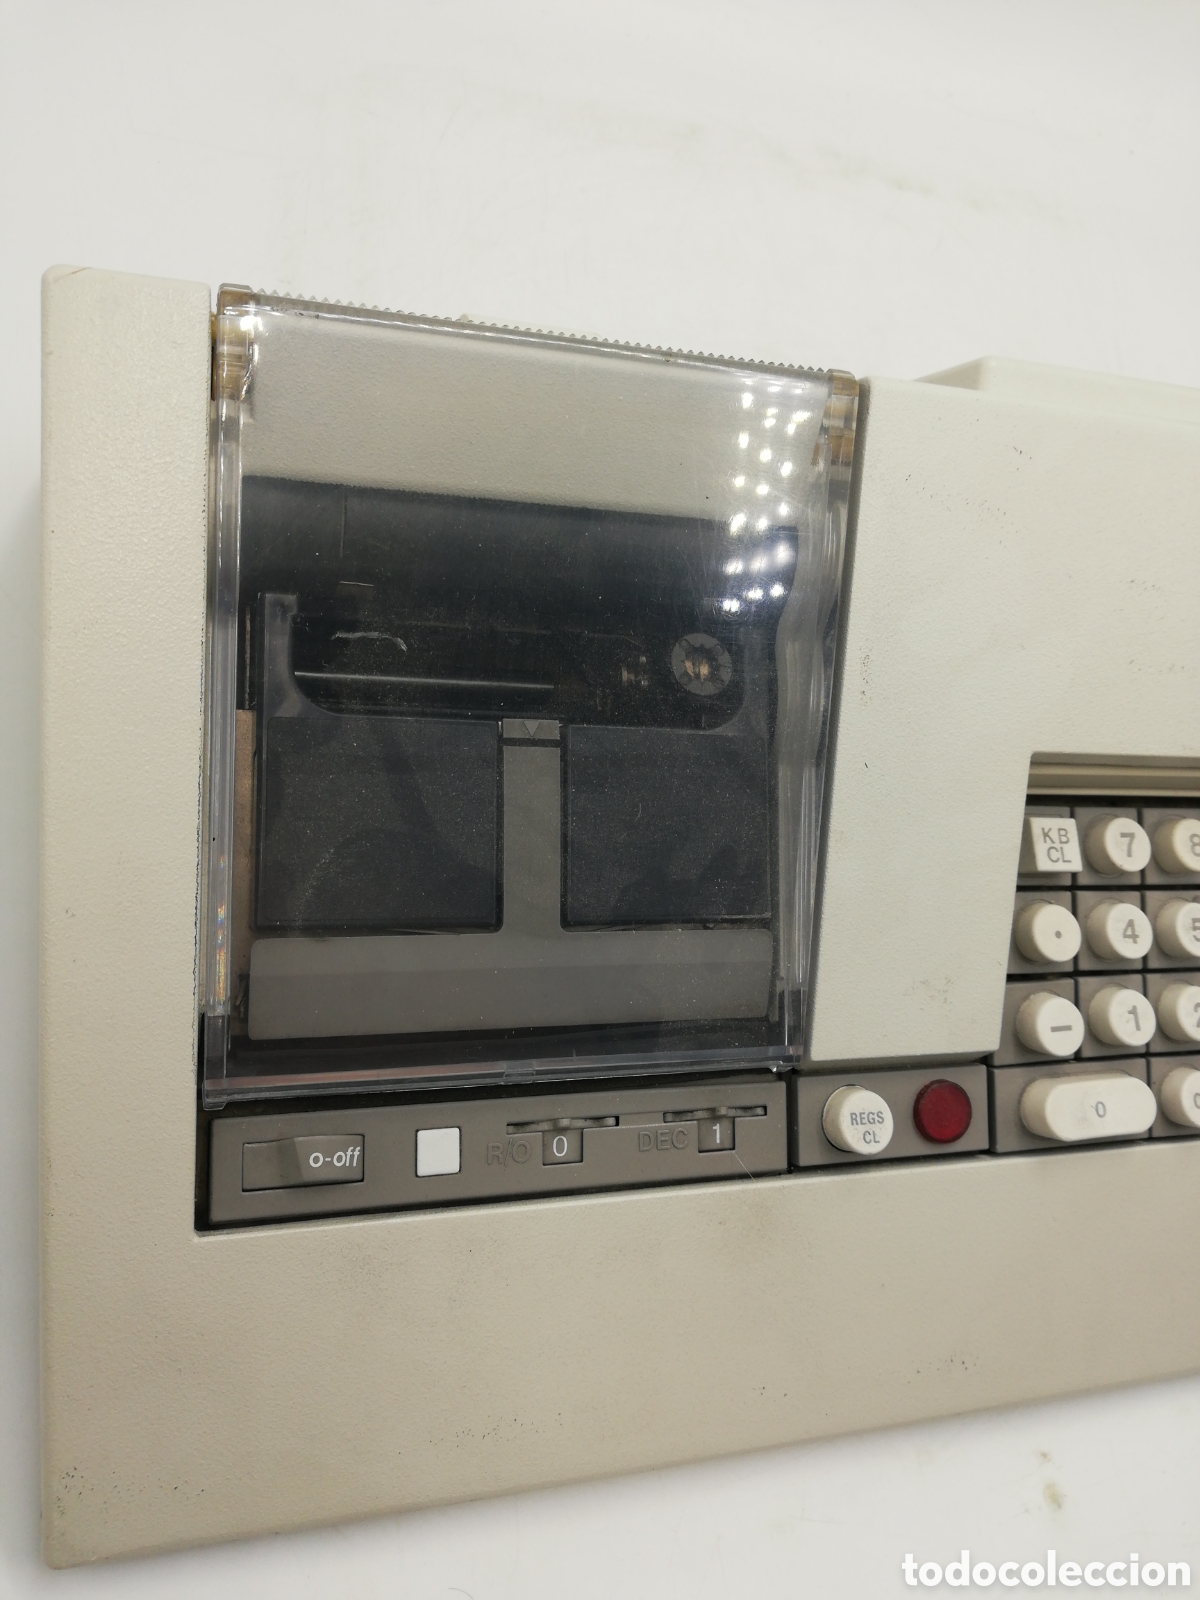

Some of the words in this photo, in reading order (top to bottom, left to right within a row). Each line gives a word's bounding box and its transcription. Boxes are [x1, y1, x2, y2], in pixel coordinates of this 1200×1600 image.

[1041, 827, 1070, 845] KB
[1120, 832, 1136, 858] 7
[1047, 846, 1072, 863] CL
[1122, 918, 1140, 944] 4
[1127, 1004, 1141, 1032] 1
[850, 1110, 885, 1126] REGS
[1094, 1100, 1107, 1119] 0
[638, 1128, 688, 1152] DEC
[712, 1123, 721, 1144] 1
[862, 1130, 880, 1144] CL
